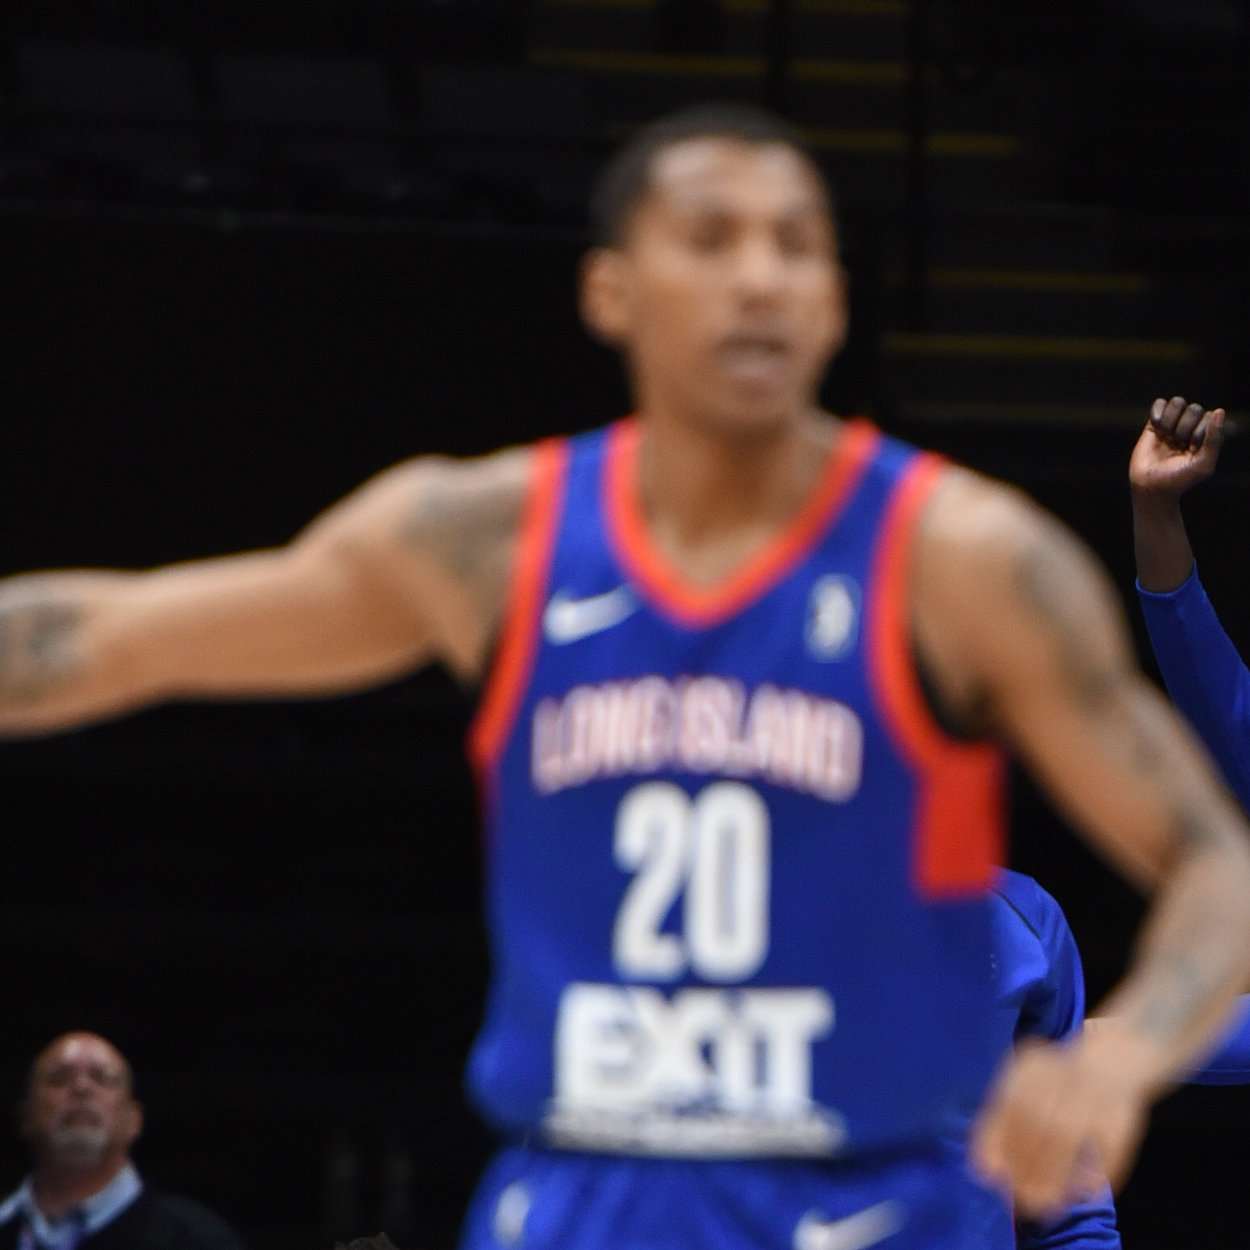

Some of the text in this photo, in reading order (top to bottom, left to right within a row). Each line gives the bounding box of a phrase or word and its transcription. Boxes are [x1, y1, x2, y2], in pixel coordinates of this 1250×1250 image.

[674, 673, 864, 803] ISLAND
[613, 781, 768, 980] 20
[554, 984, 833, 1113] EXIT
